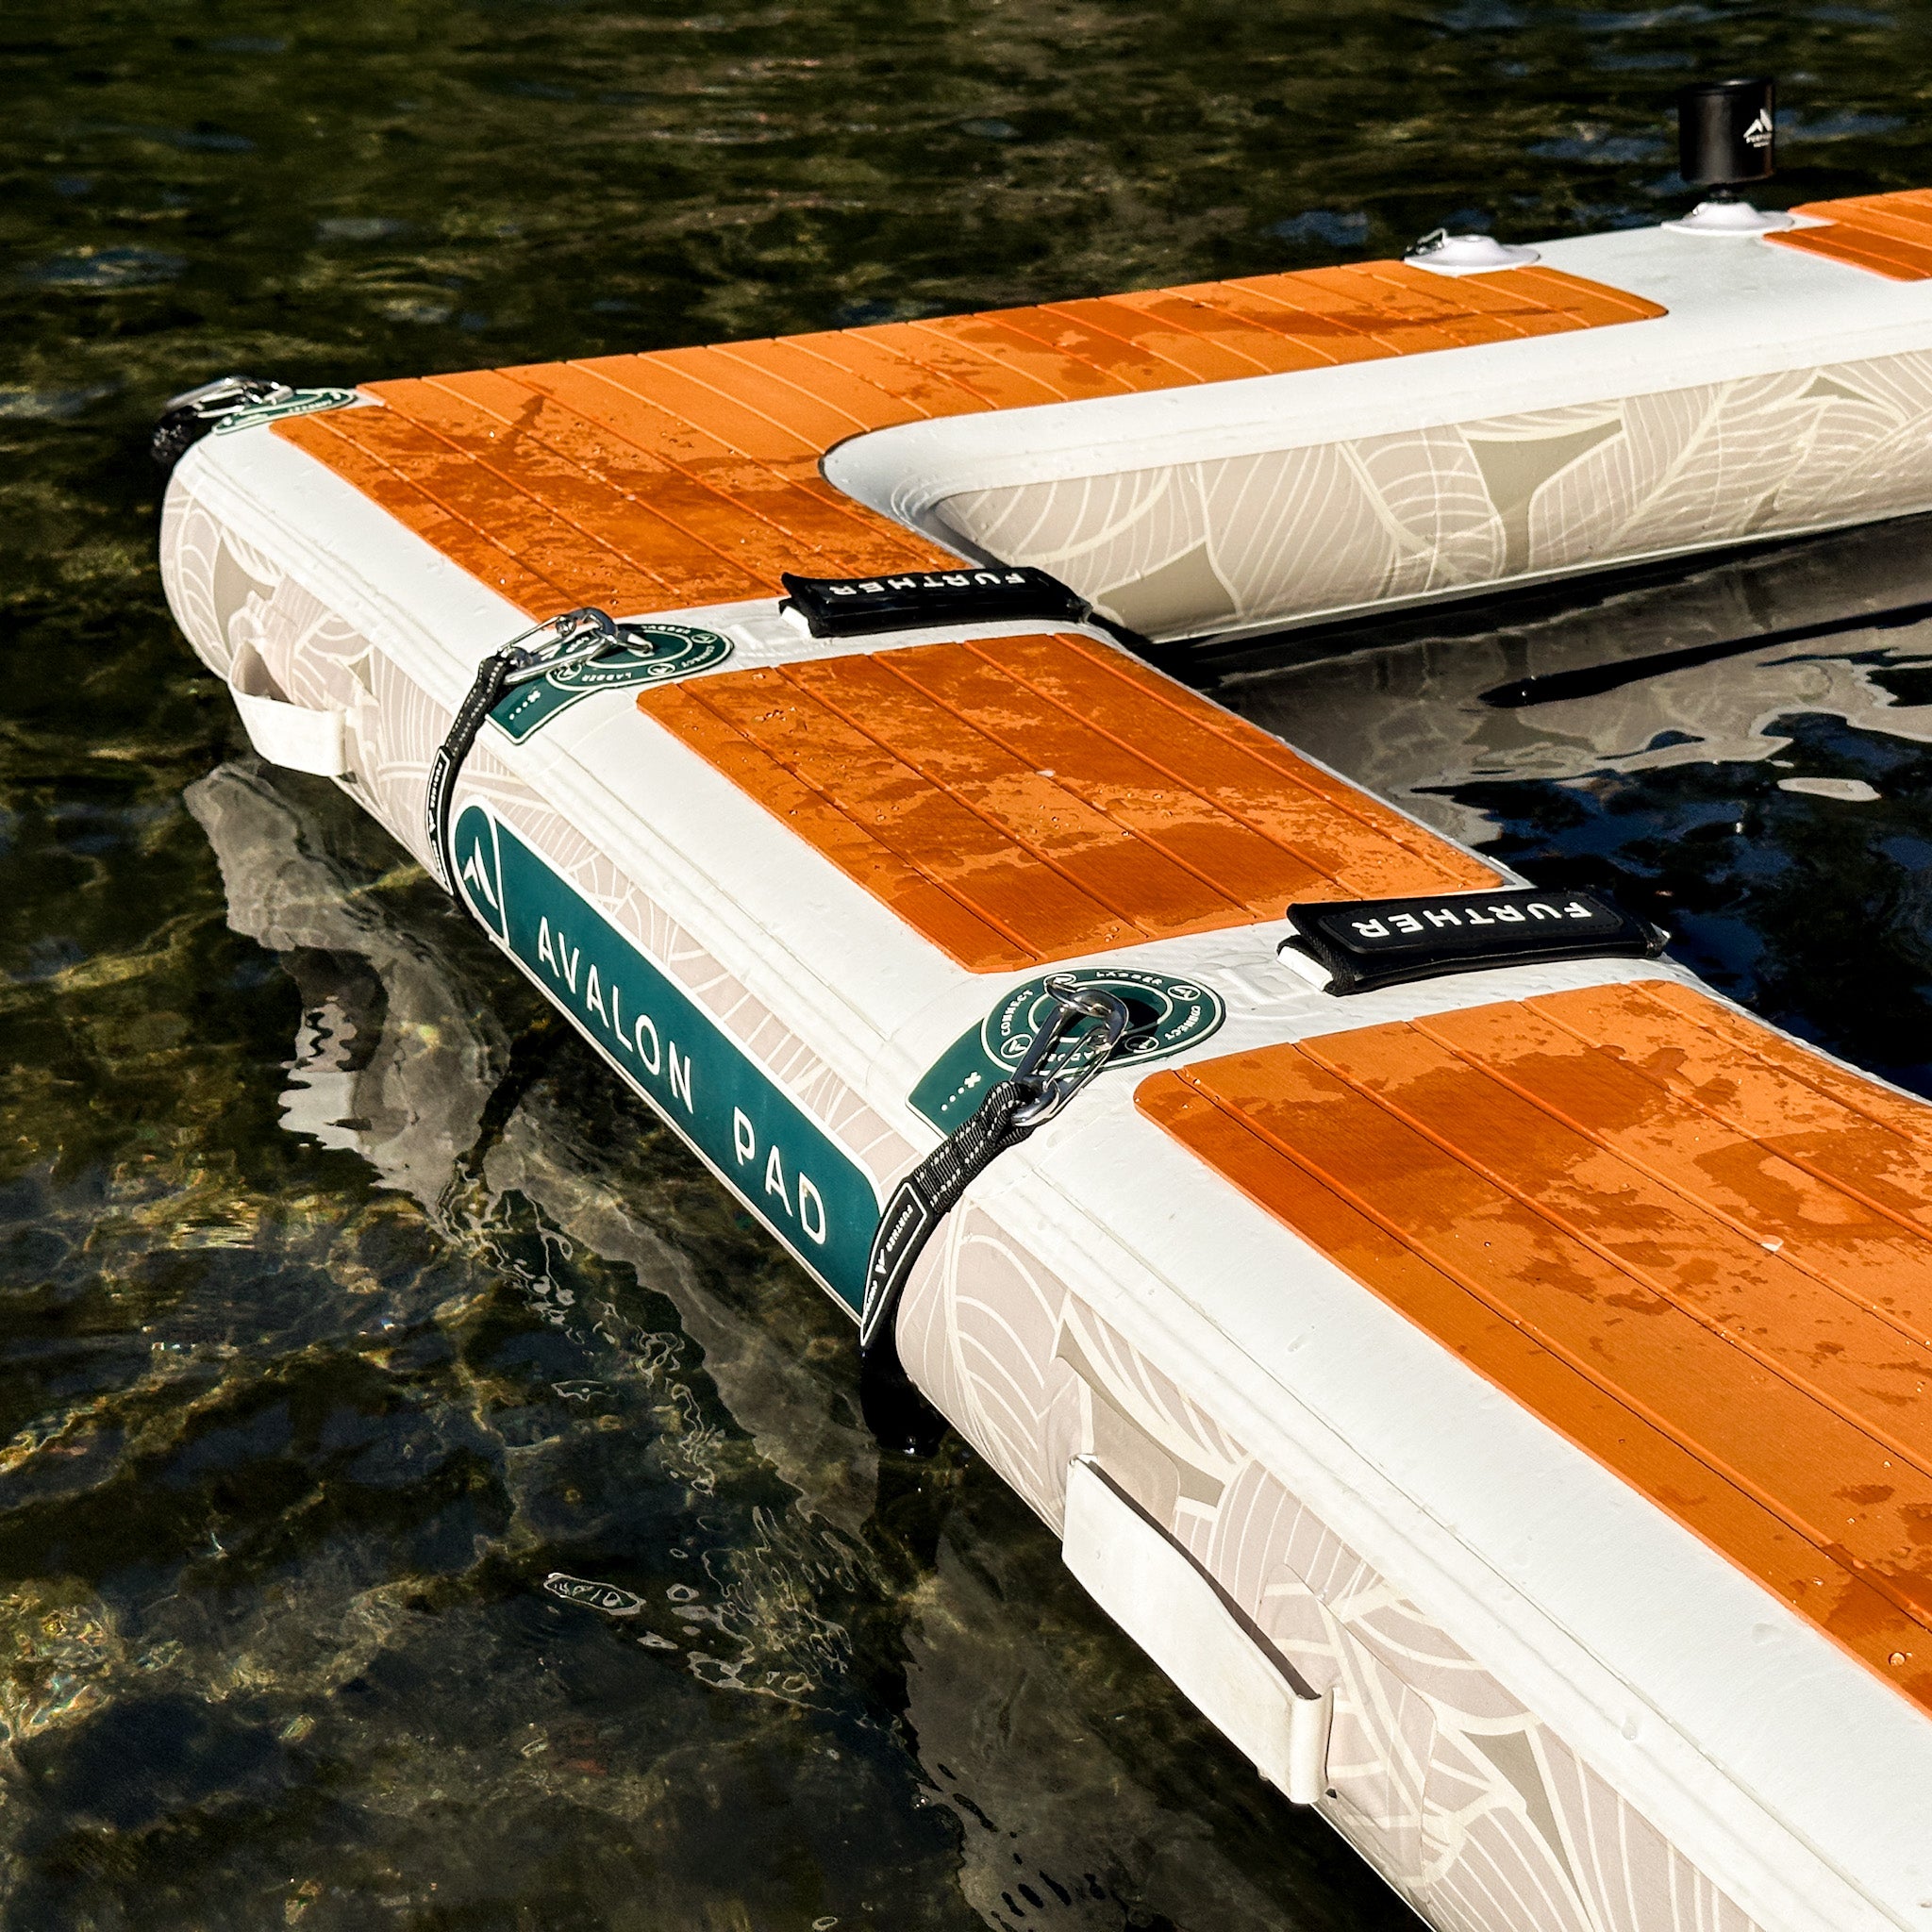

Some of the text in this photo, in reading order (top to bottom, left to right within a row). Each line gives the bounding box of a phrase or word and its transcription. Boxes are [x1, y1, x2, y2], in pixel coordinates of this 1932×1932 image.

[830, 573, 1025, 595] FURTHER
[1351, 902, 1592, 937] FURTHER
[1095, 971, 1164, 985] LADDER
[1001, 989, 1034, 1037] CONNECT
[1164, 1005, 1201, 1041] CONNECT
[538, 916, 826, 1245] AVALON PAD
[886, 1205, 914, 1253] FURTHER
